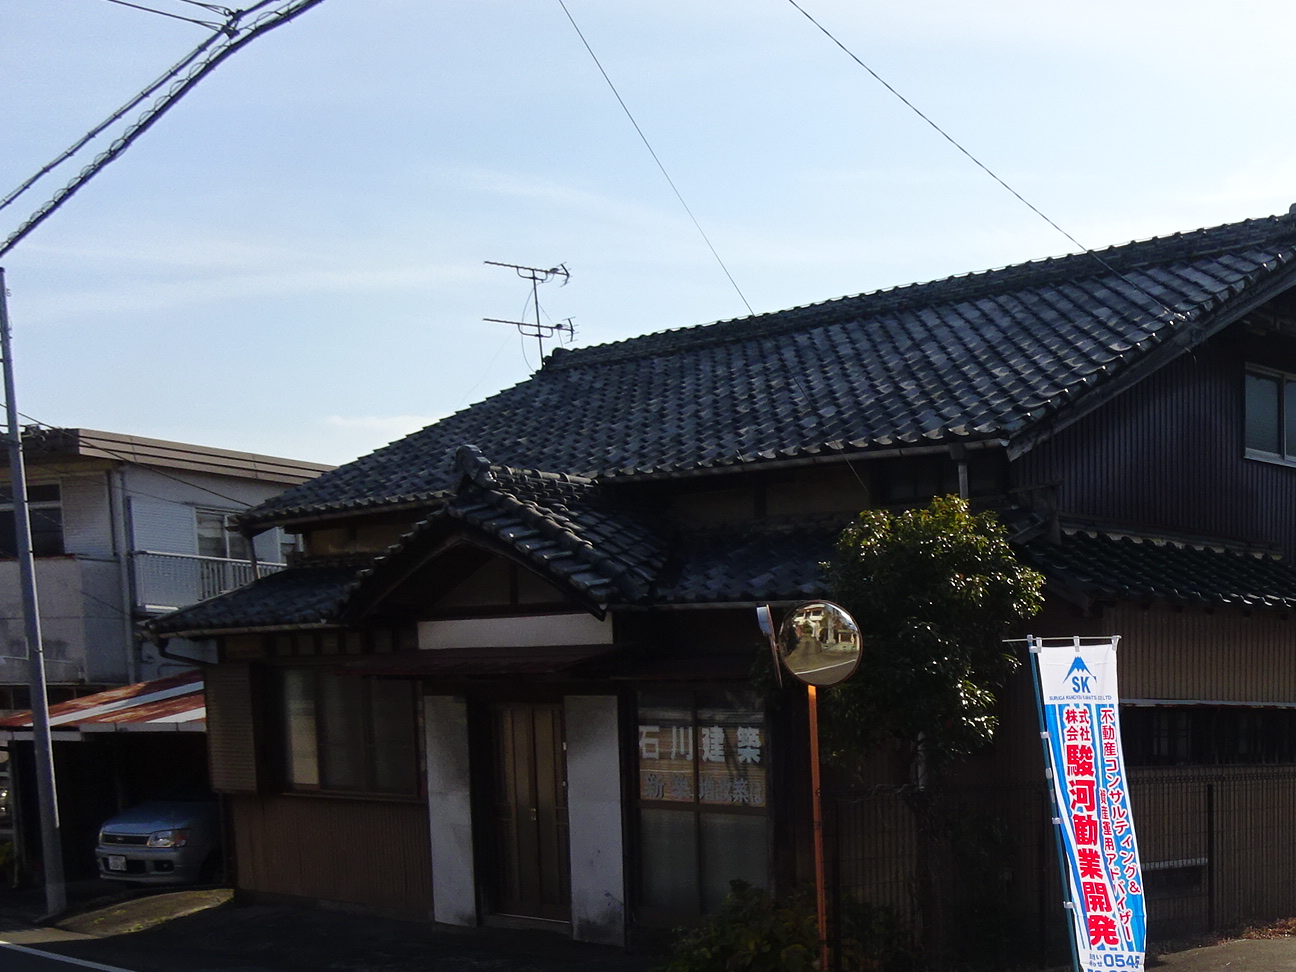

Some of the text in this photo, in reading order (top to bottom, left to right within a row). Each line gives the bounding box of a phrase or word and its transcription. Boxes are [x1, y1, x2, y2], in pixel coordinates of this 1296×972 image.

[1072, 676, 1091, 694] SK
[638, 725, 762, 764] 石川建築
[1066, 744, 1119, 946] 駿河勧業開発
